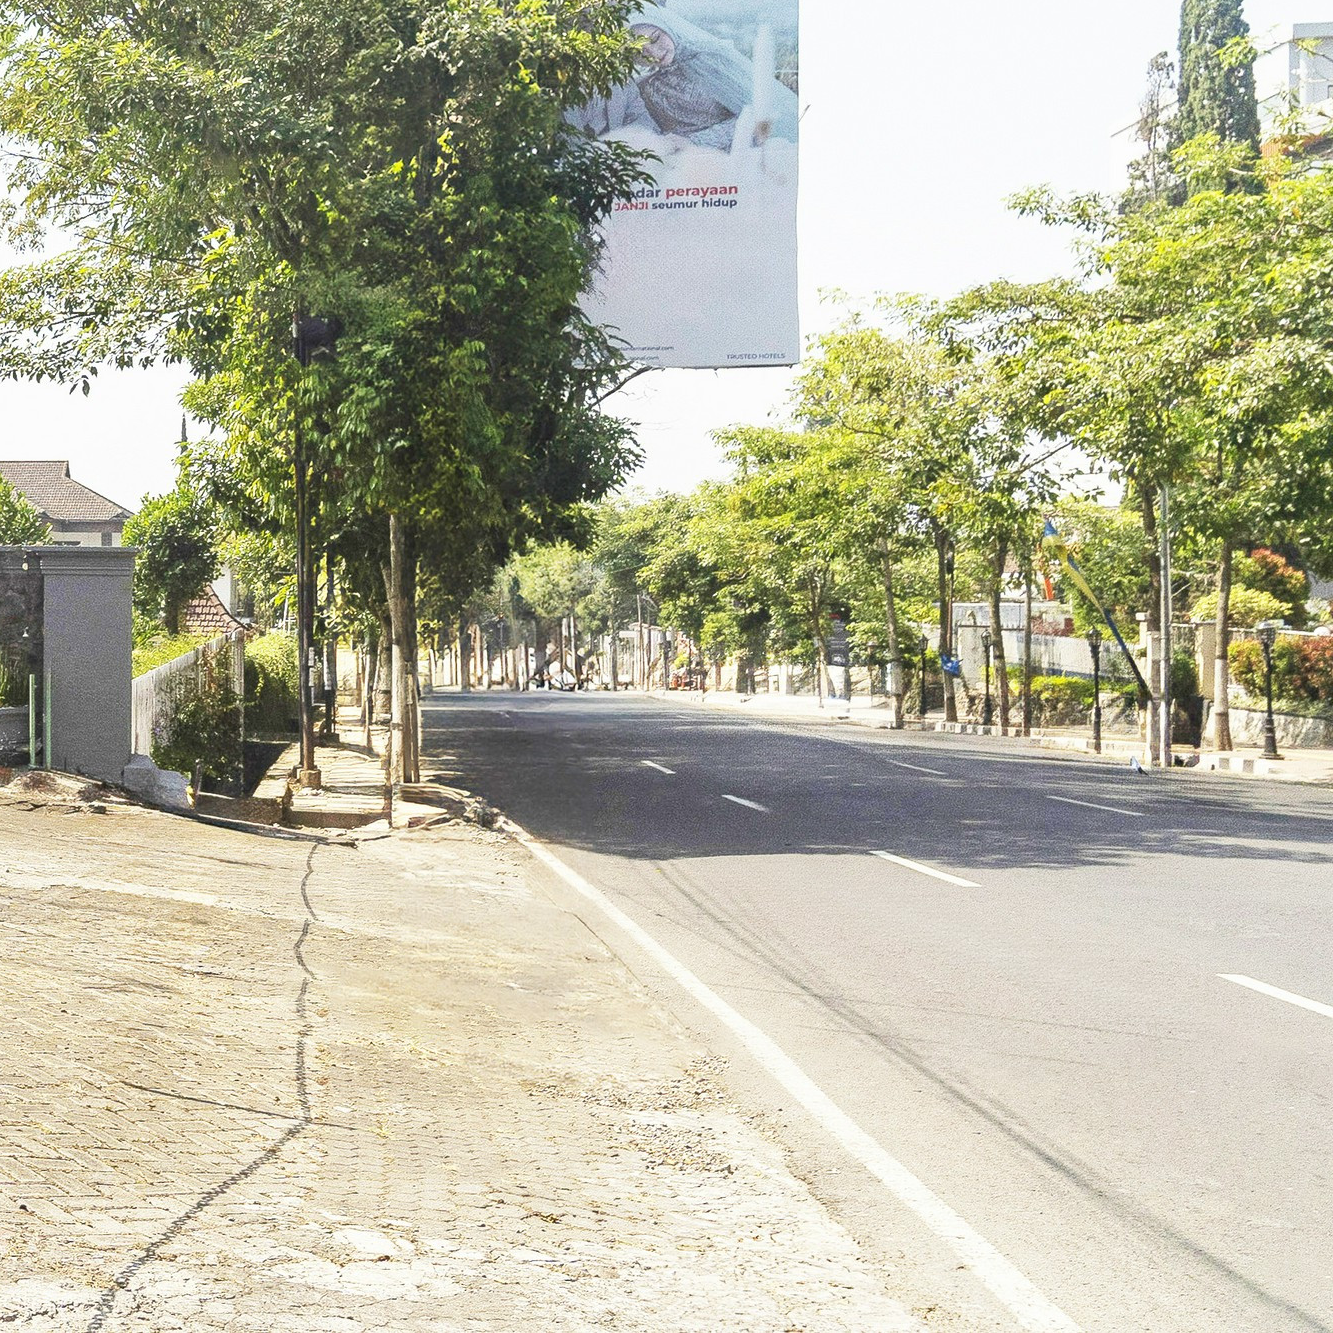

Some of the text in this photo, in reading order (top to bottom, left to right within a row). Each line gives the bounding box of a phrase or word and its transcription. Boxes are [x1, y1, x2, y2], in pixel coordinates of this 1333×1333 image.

[665, 185, 738, 199] perayaan
[614, 198, 738, 212] JANJI seumur hidup
